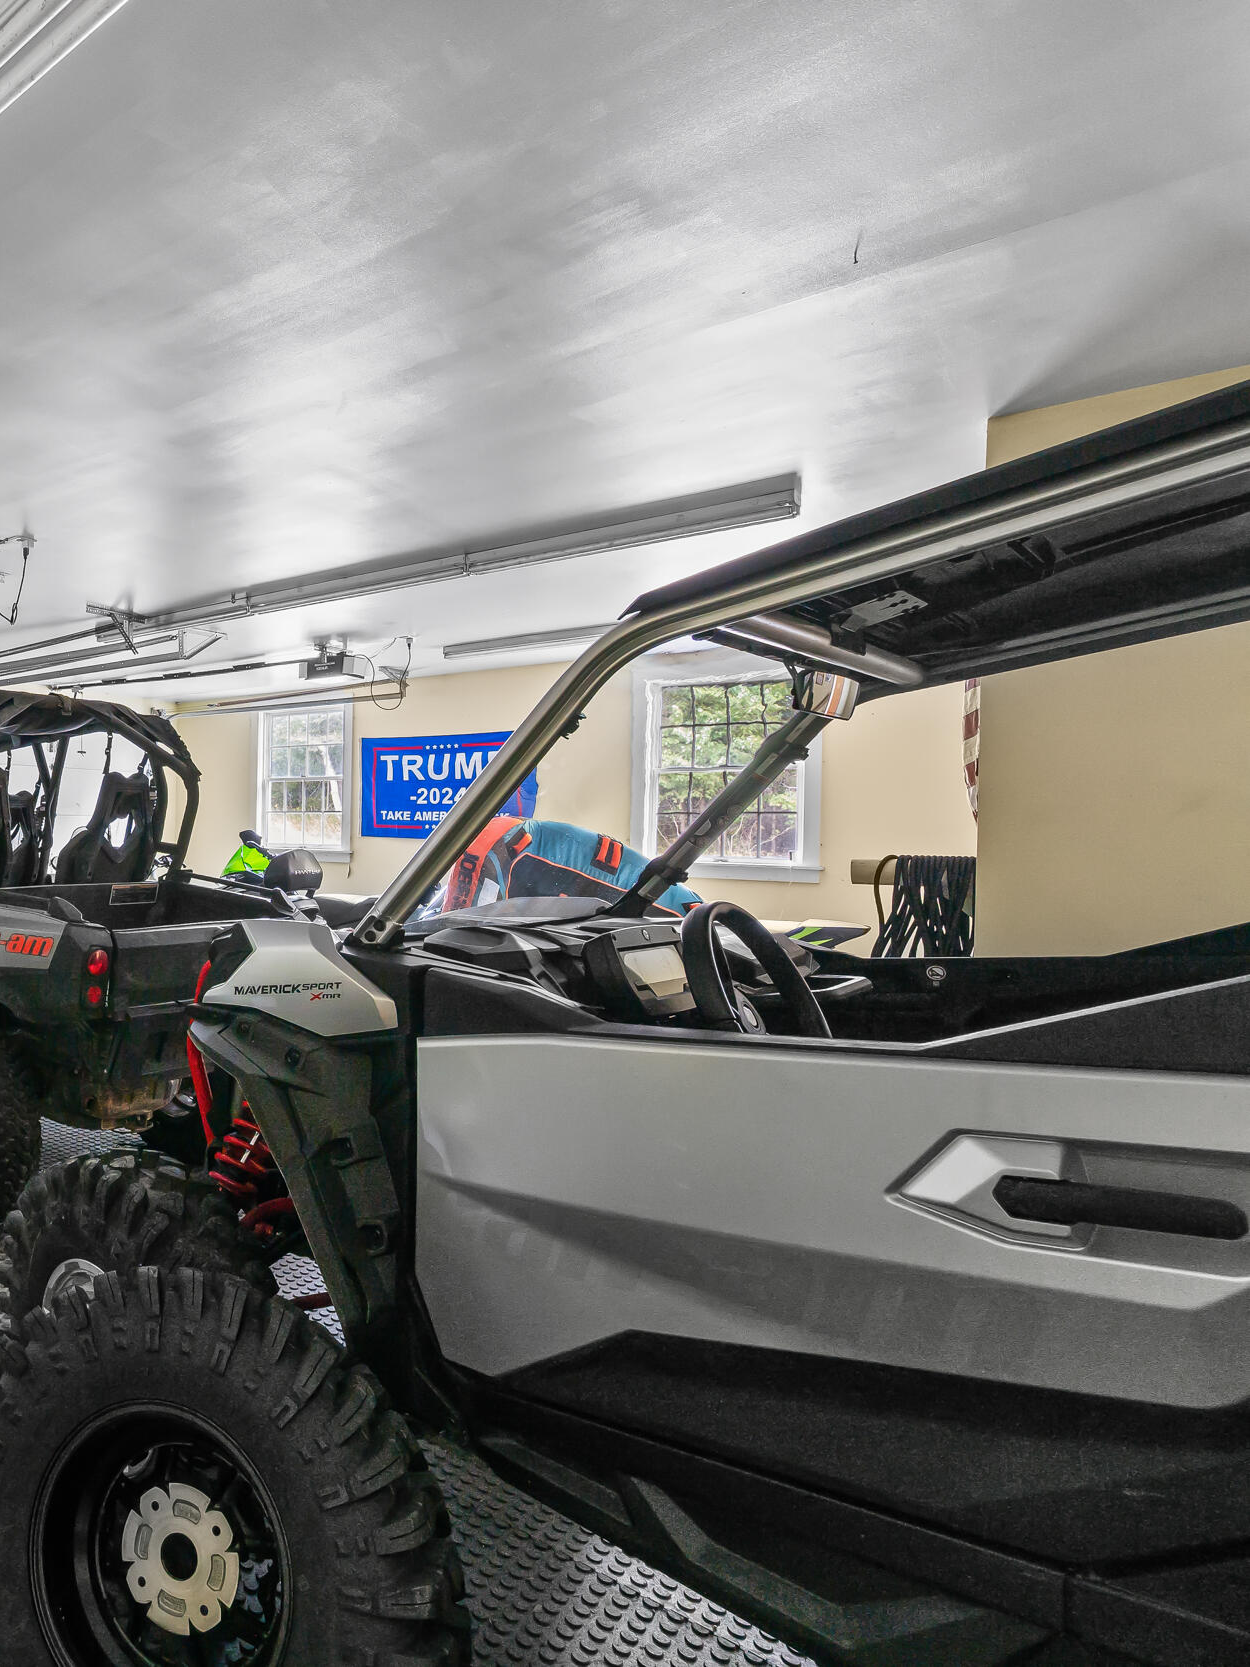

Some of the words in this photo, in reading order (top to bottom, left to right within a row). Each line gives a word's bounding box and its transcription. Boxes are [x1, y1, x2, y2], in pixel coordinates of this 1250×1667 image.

[380, 811, 411, 821] TAKE
[413, 811, 447, 822] AMER
[234, 983, 302, 996] MAVERICK
[302, 982, 342, 991] SPORT
